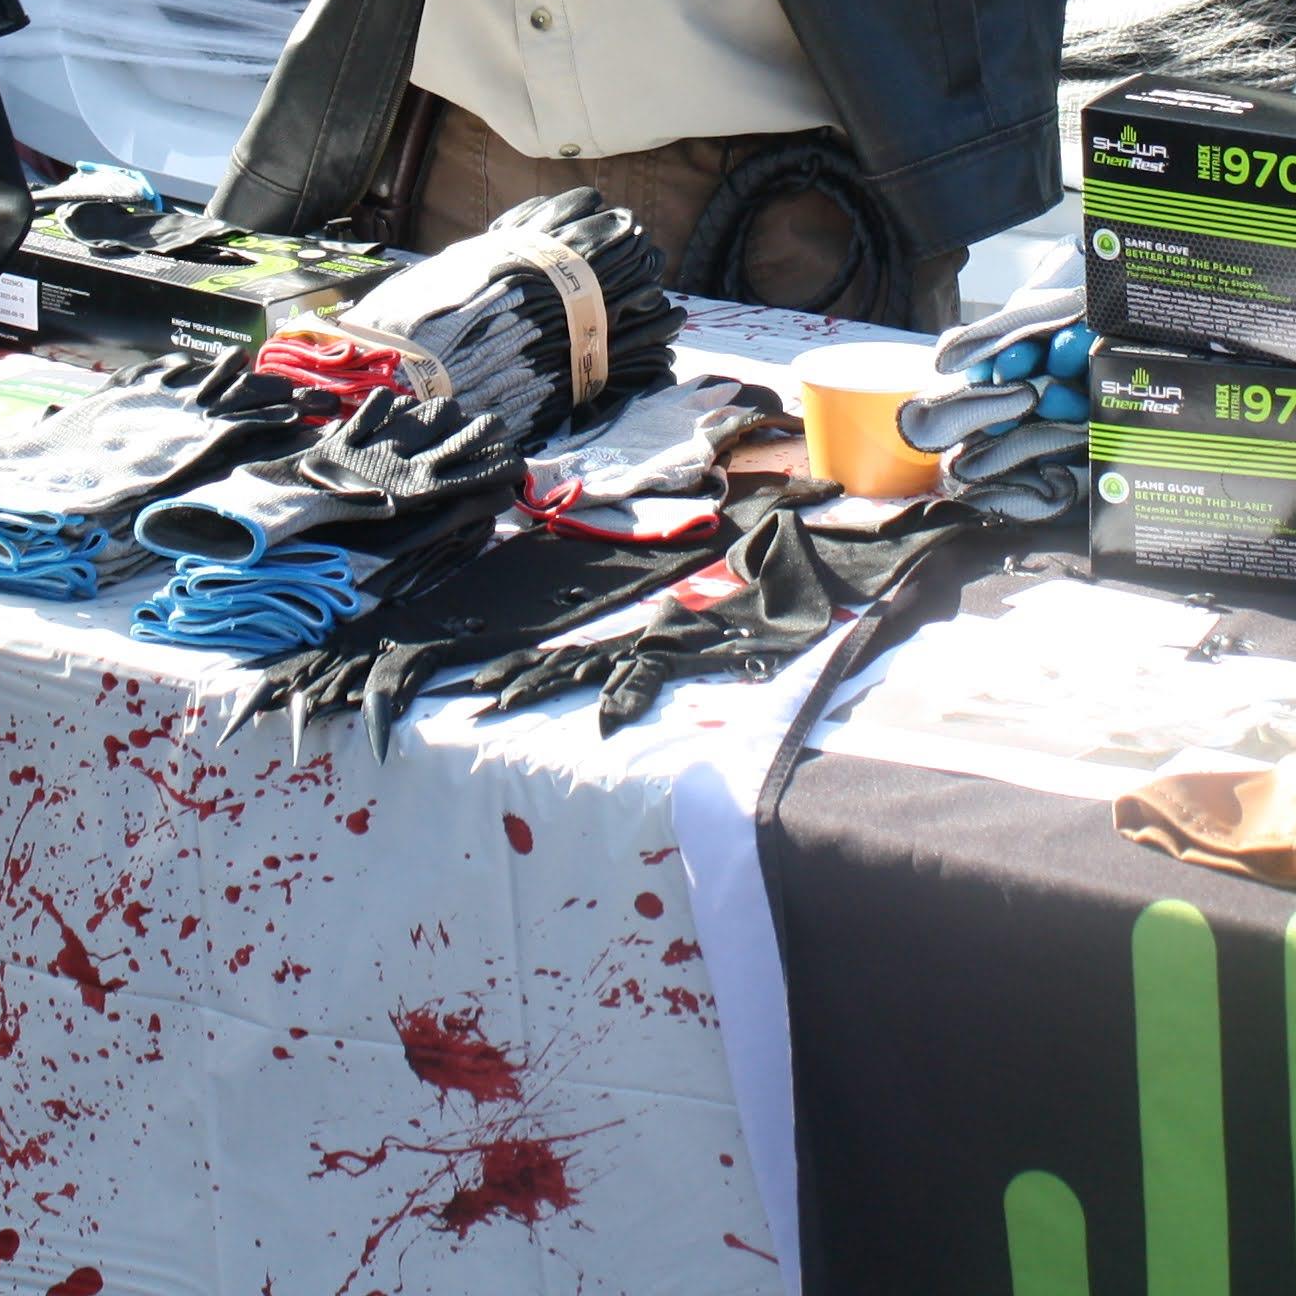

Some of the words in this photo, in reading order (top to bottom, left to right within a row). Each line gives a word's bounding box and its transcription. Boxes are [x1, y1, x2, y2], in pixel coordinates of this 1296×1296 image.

[1092, 136, 1168, 159] SHOWA
[1093, 151, 1166, 173] ChemRest
[1125, 237, 1153, 250] SAME
[1155, 242, 1189, 256] GLOVE
[1125, 248, 1164, 262] BETTER
[1166, 255, 1188, 266] FOR
[1190, 258, 1210, 270] THE
[1212, 262, 1253, 276] PLANET
[215, 327, 252, 342] PROTECTED
[1101, 380, 1182, 400] SHOWA
[1101, 396, 1180, 415] ChemRest
[1134, 480, 1165, 492] SAME
[1167, 483, 1205, 496] GLOVE
[1134, 491, 1176, 503] BETTER
[1180, 495, 1202, 505] FOR
[1206, 498, 1228, 508] THE
[1230, 500, 1273, 513] PLANET
